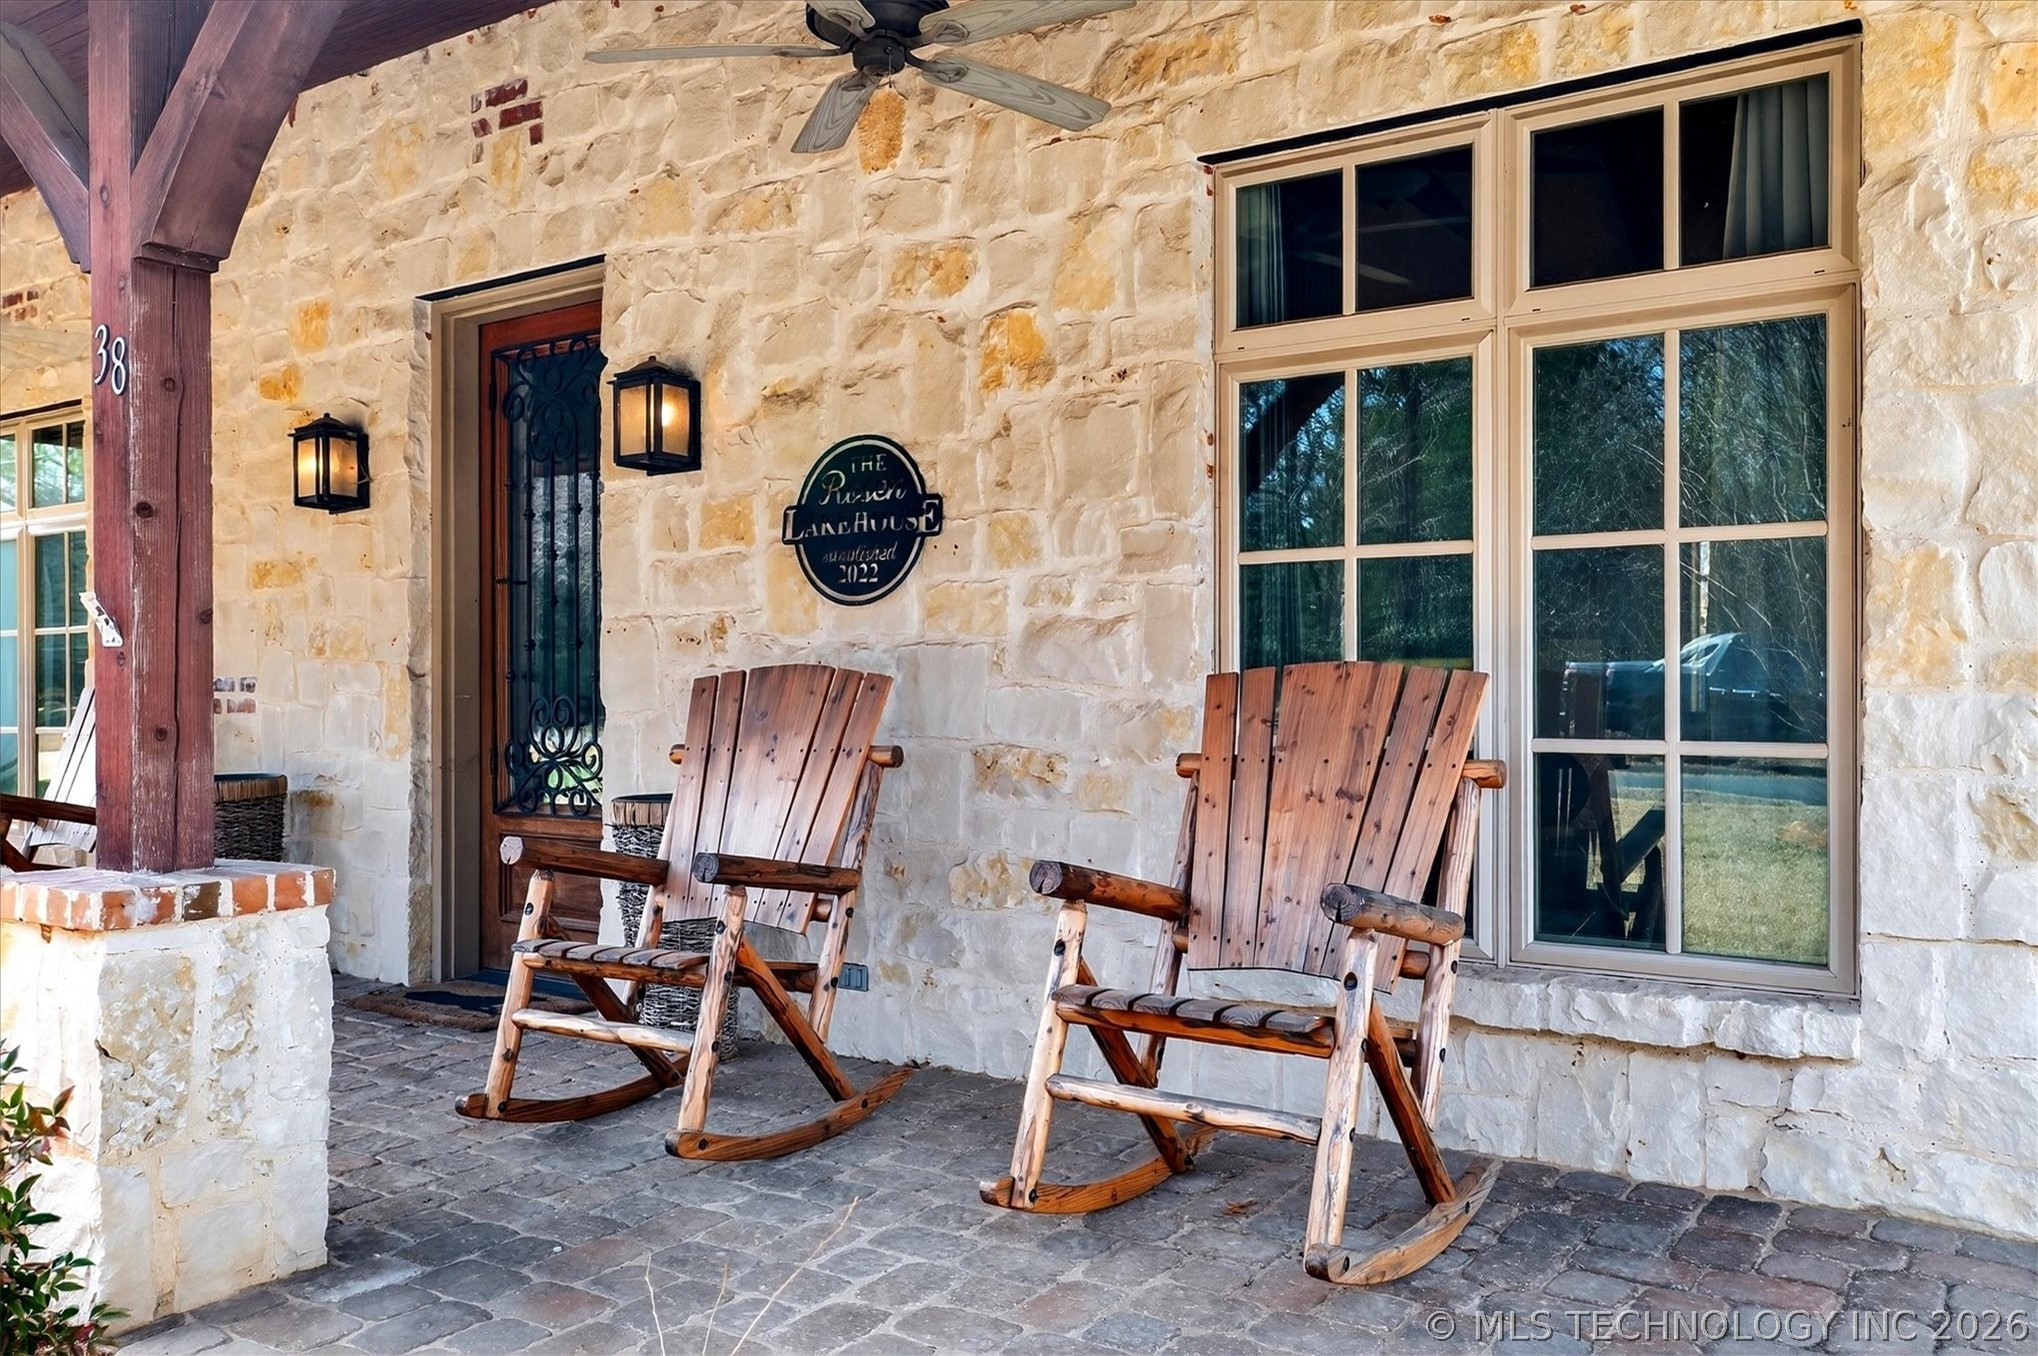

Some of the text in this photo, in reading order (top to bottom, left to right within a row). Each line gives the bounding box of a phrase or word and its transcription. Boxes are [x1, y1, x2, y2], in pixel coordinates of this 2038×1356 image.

[94, 324, 126, 395] 38
[851, 453, 887, 473] THE
[838, 563, 879, 583] 2022
